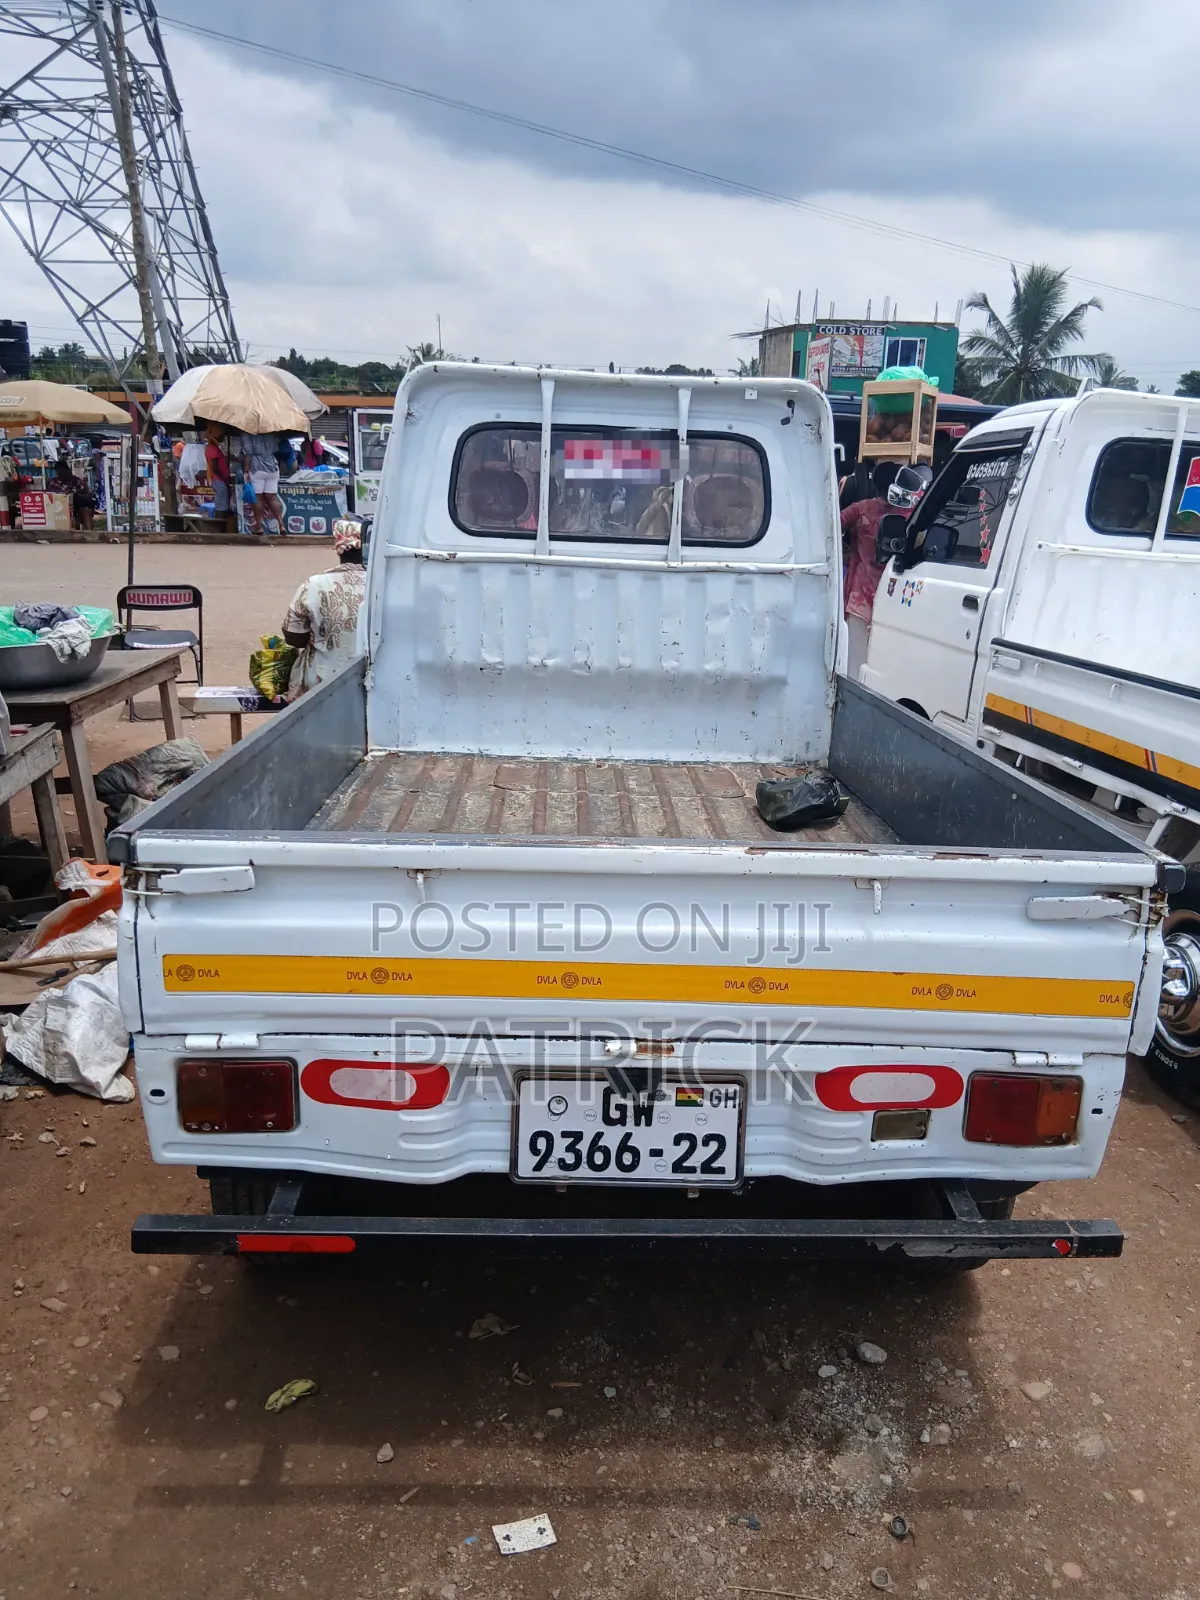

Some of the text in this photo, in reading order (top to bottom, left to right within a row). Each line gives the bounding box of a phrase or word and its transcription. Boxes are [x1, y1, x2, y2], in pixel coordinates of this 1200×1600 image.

[819, 326, 882, 336] COLD STORE
[127, 592, 192, 605] KUMAWU
[163, 968, 1120, 1004] LA DVLA DVLA DVLA DVLA DVLA DVLA DVLA DVLA DVLA DVLA
[602, 1085, 656, 1128] GW
[709, 1087, 738, 1109] GH
[529, 1130, 727, 1175] 9366-22
